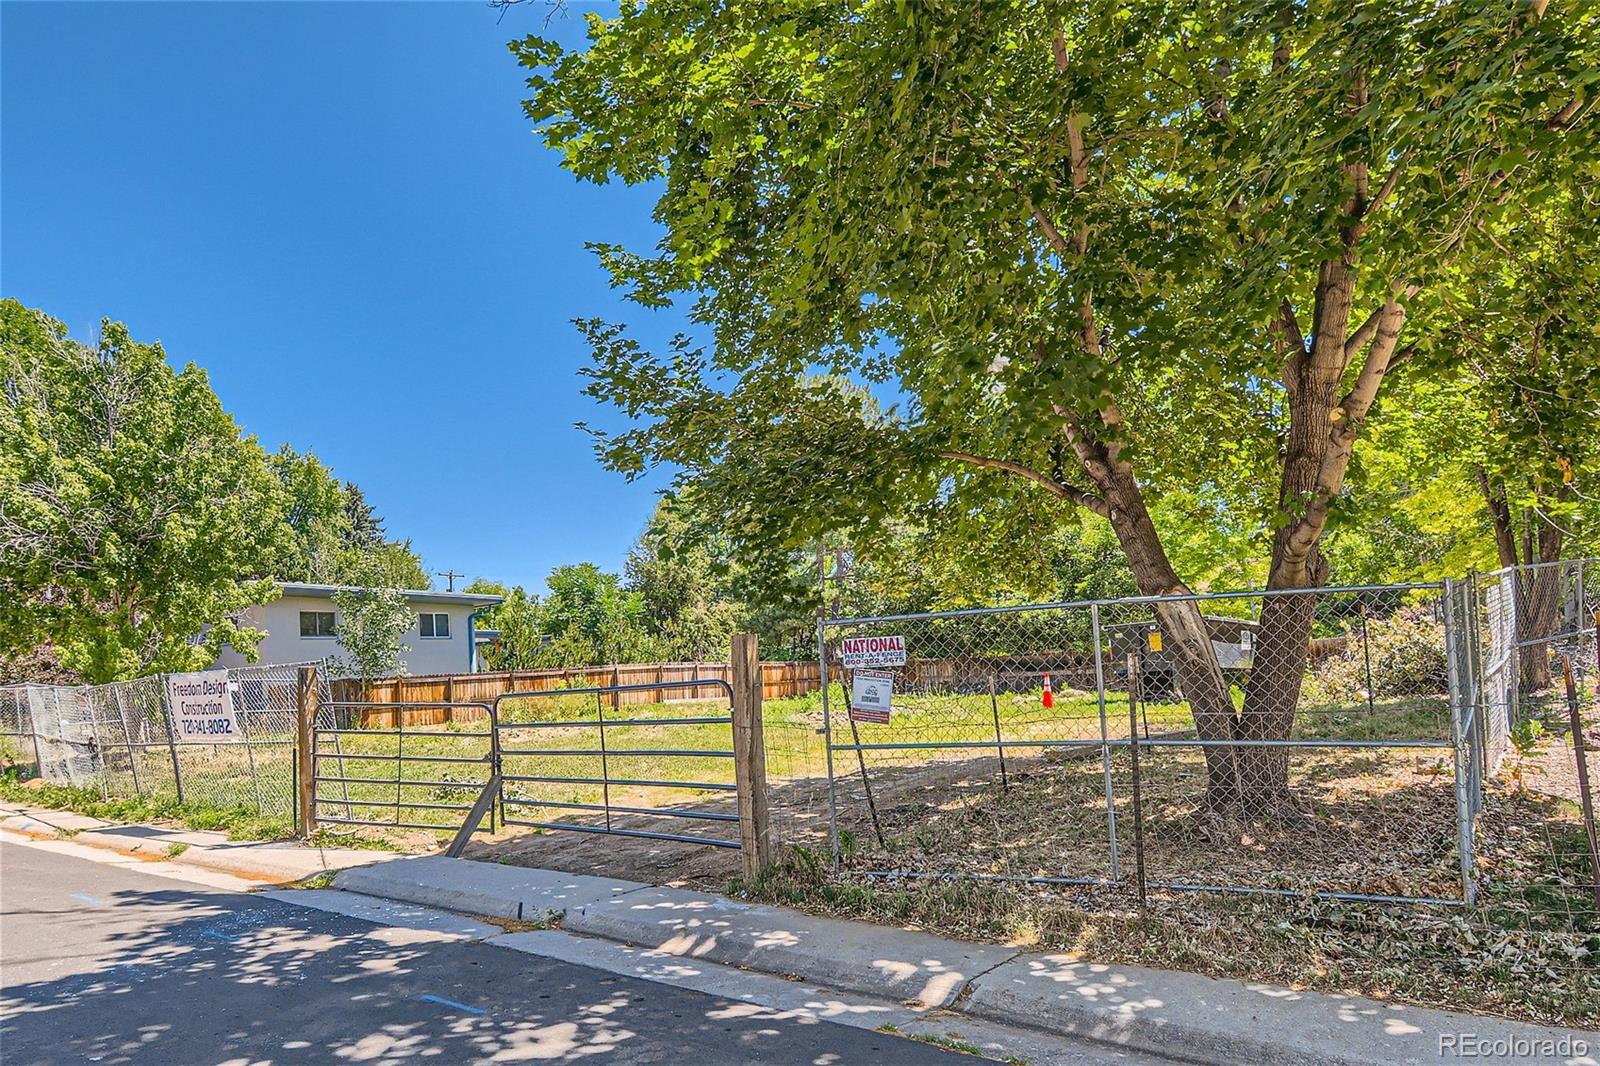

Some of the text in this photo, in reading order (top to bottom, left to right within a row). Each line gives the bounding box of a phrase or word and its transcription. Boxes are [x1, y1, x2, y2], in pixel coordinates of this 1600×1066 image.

[844, 637, 903, 653] NATIONAL
[844, 651, 905, 660] RENT-A-FENCE
[845, 657, 905, 666] 800-352-5675
[173, 679, 229, 698] Freedom Design
[181, 699, 223, 715] Construction
